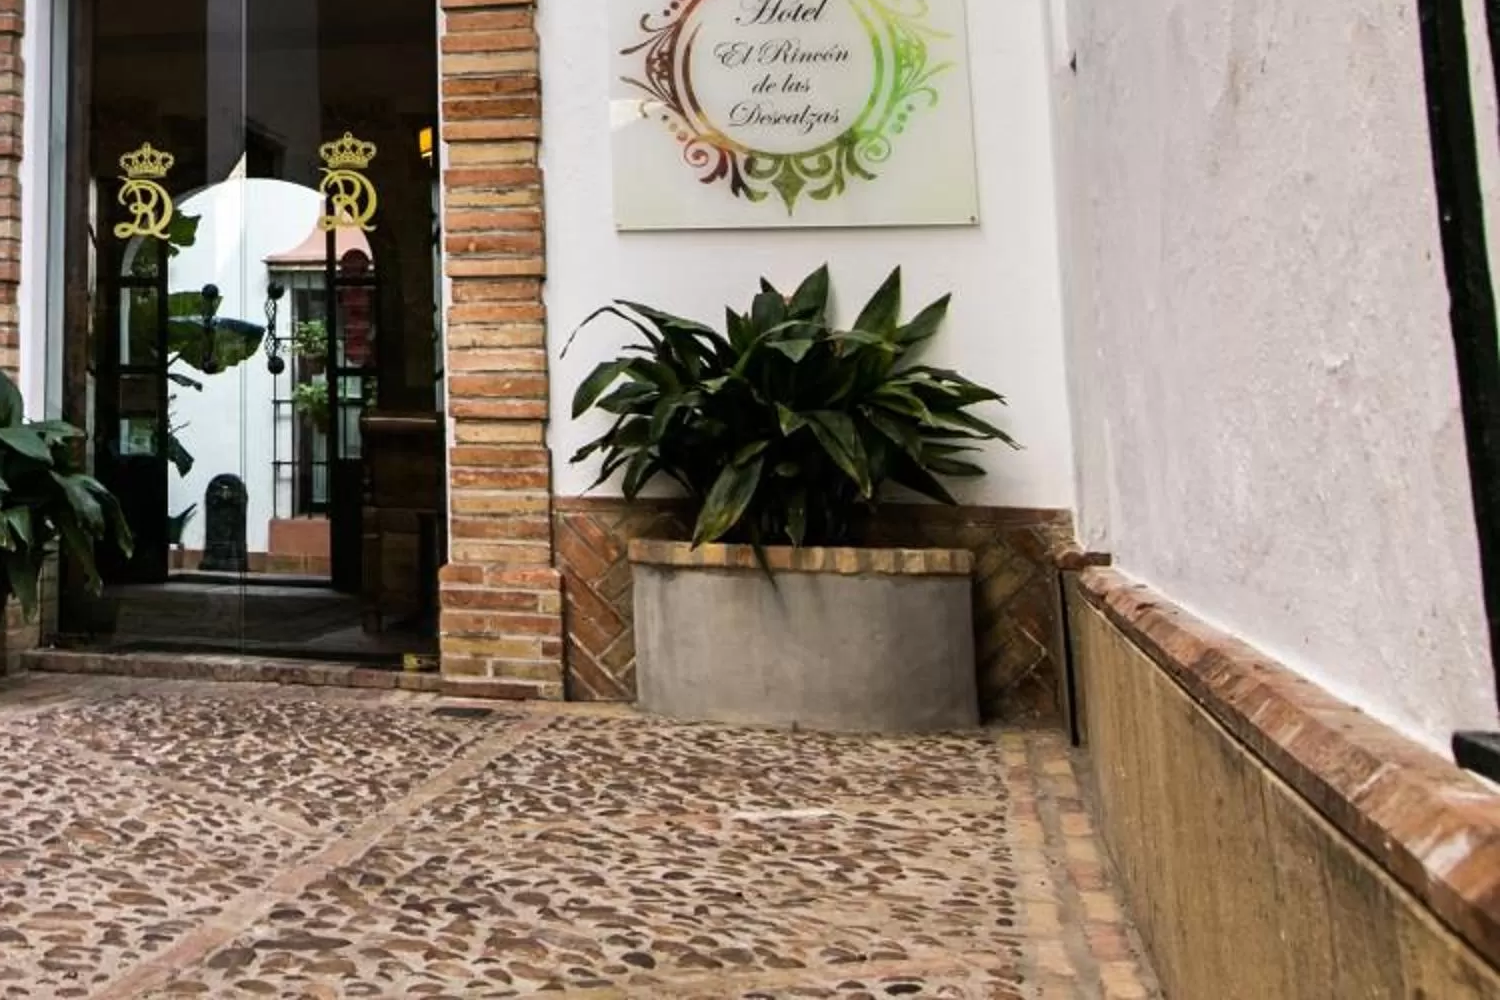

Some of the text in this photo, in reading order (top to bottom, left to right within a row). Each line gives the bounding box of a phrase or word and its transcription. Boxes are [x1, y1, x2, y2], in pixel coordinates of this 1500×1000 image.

[713, 38, 849, 68] El Rincón
[751, 73, 811, 94] de las
[728, 100, 840, 134] Descalzas
